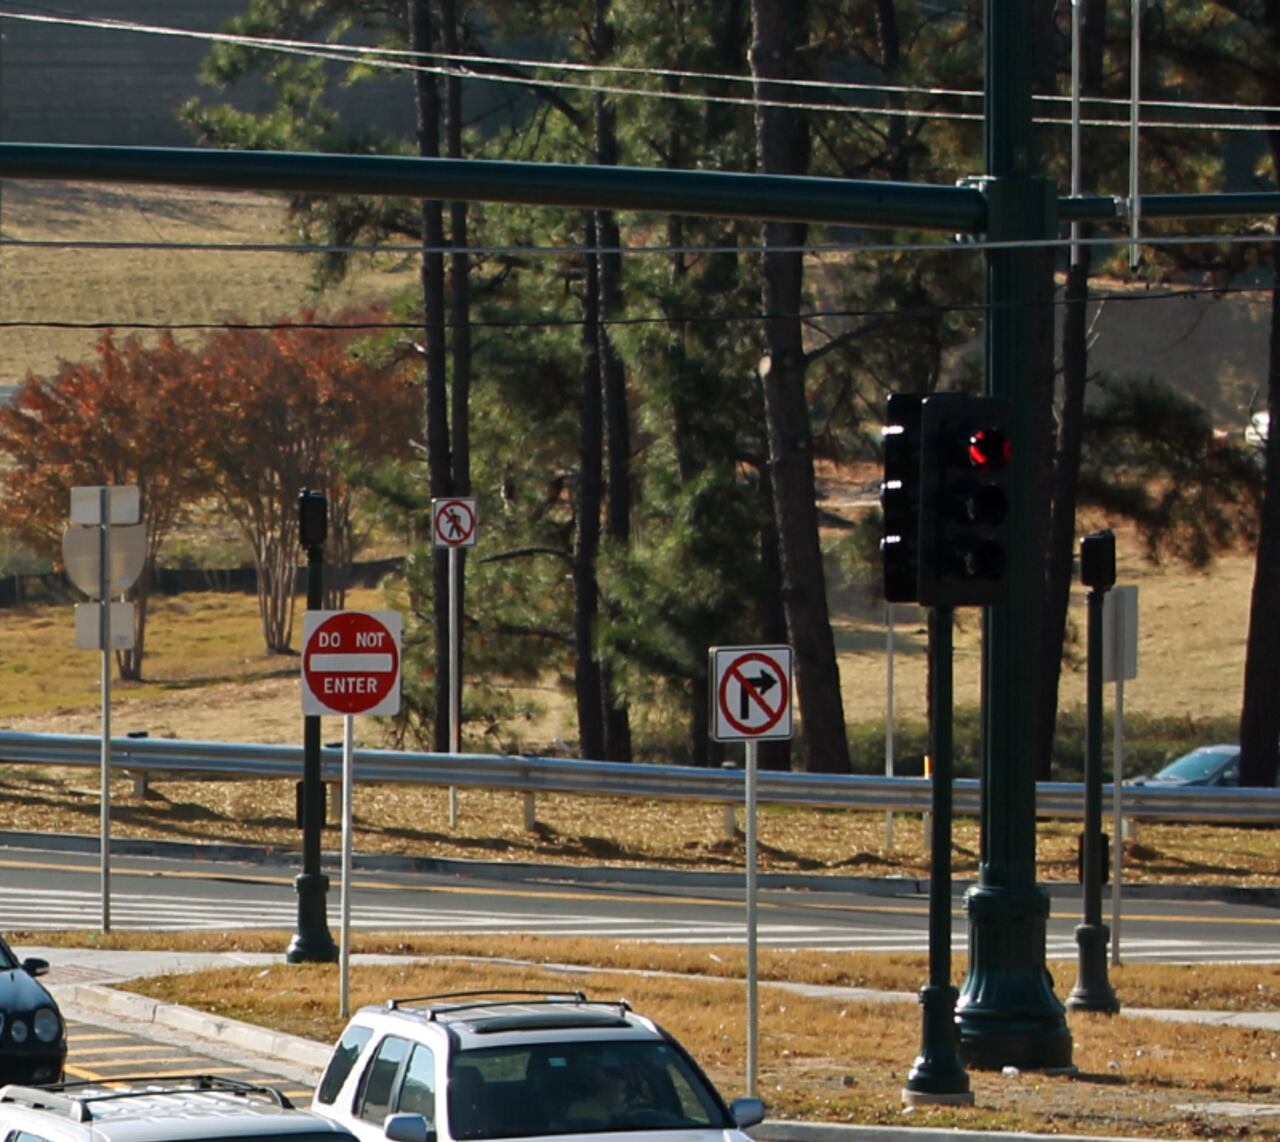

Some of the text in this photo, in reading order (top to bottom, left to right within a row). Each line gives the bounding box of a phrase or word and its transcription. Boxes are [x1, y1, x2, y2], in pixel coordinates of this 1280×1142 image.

[318, 632, 385, 648] DO NOT
[324, 678, 378, 694] ENTER
